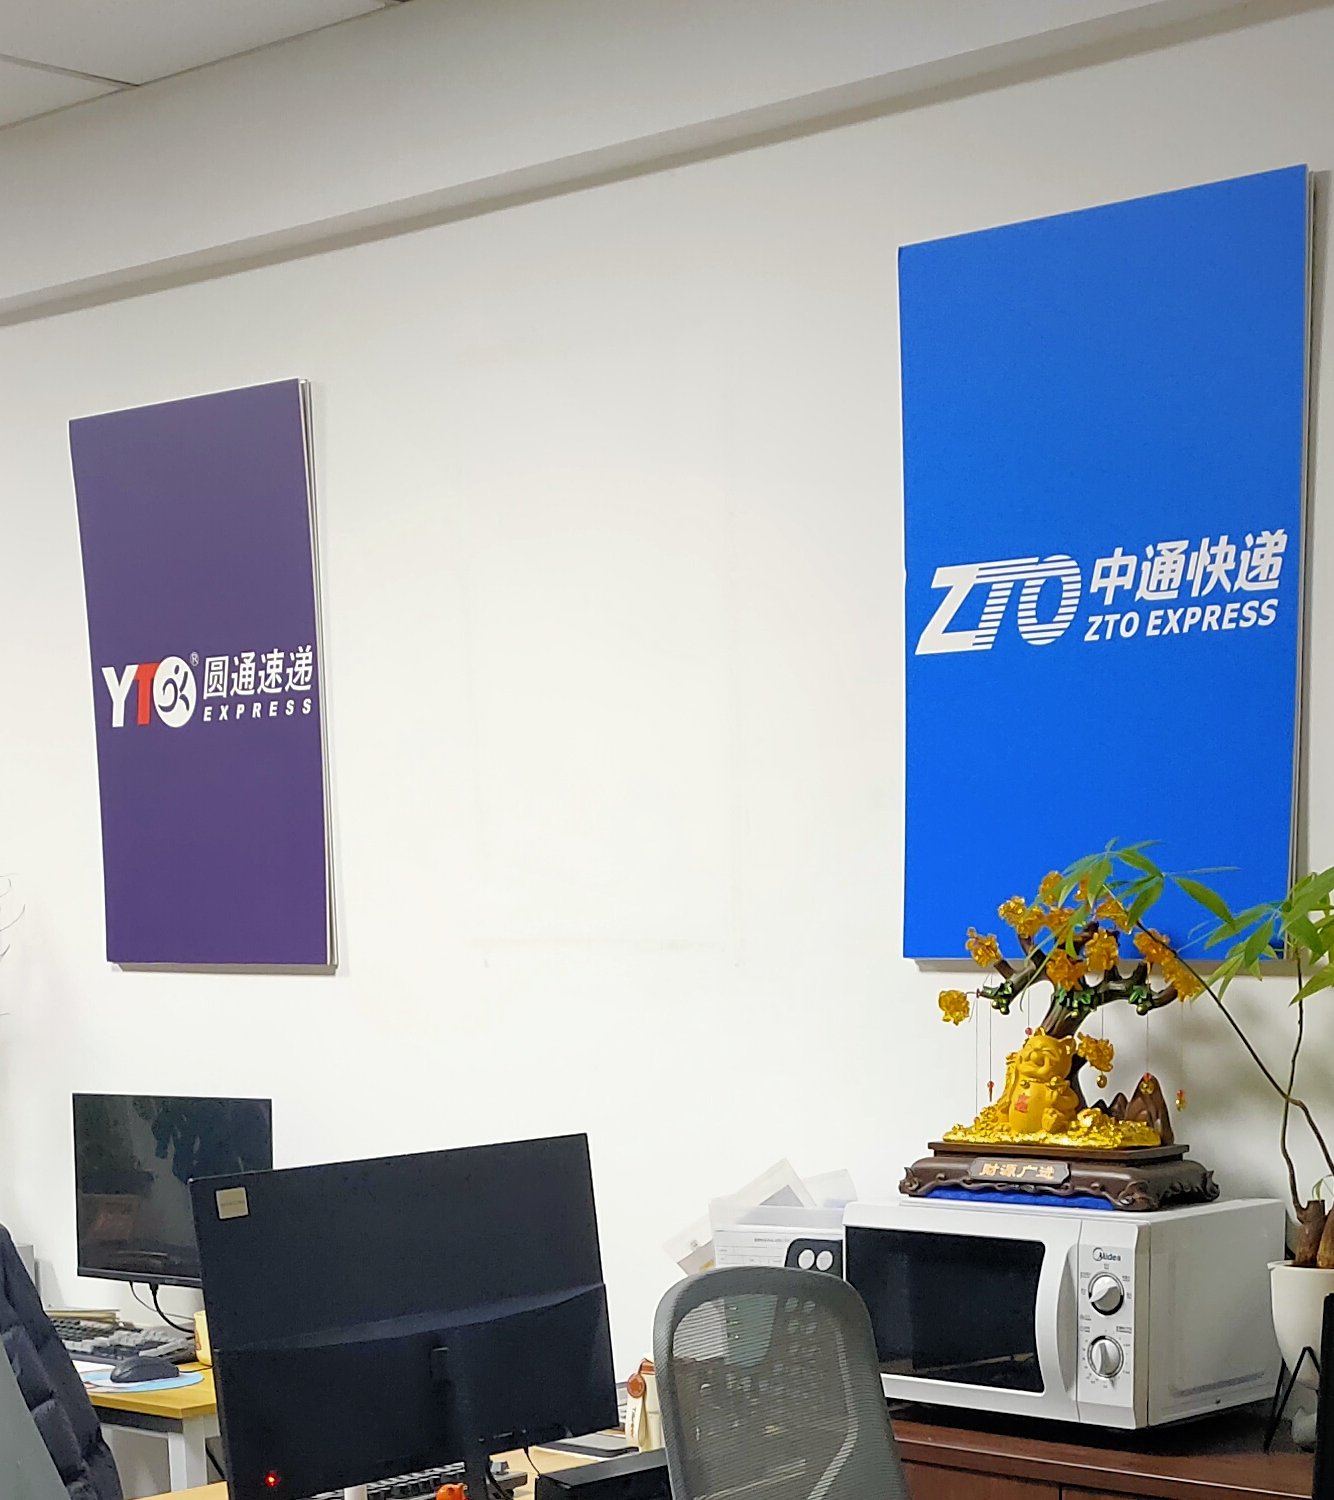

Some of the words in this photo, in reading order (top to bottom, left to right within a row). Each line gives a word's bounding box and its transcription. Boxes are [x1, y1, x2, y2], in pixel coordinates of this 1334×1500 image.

[1089, 529, 1288, 606] 中通快递
[914, 554, 1081, 655] ZTO
[1084, 611, 1140, 642] ZTO
[1145, 599, 1278, 637] EXPRESS
[203, 644, 313, 699] 圆通速递
[203, 698, 312, 722] EXPRESS
[979, 1162, 1055, 1180] 财源广进
[1094, 1249, 1121, 1261] Midea
